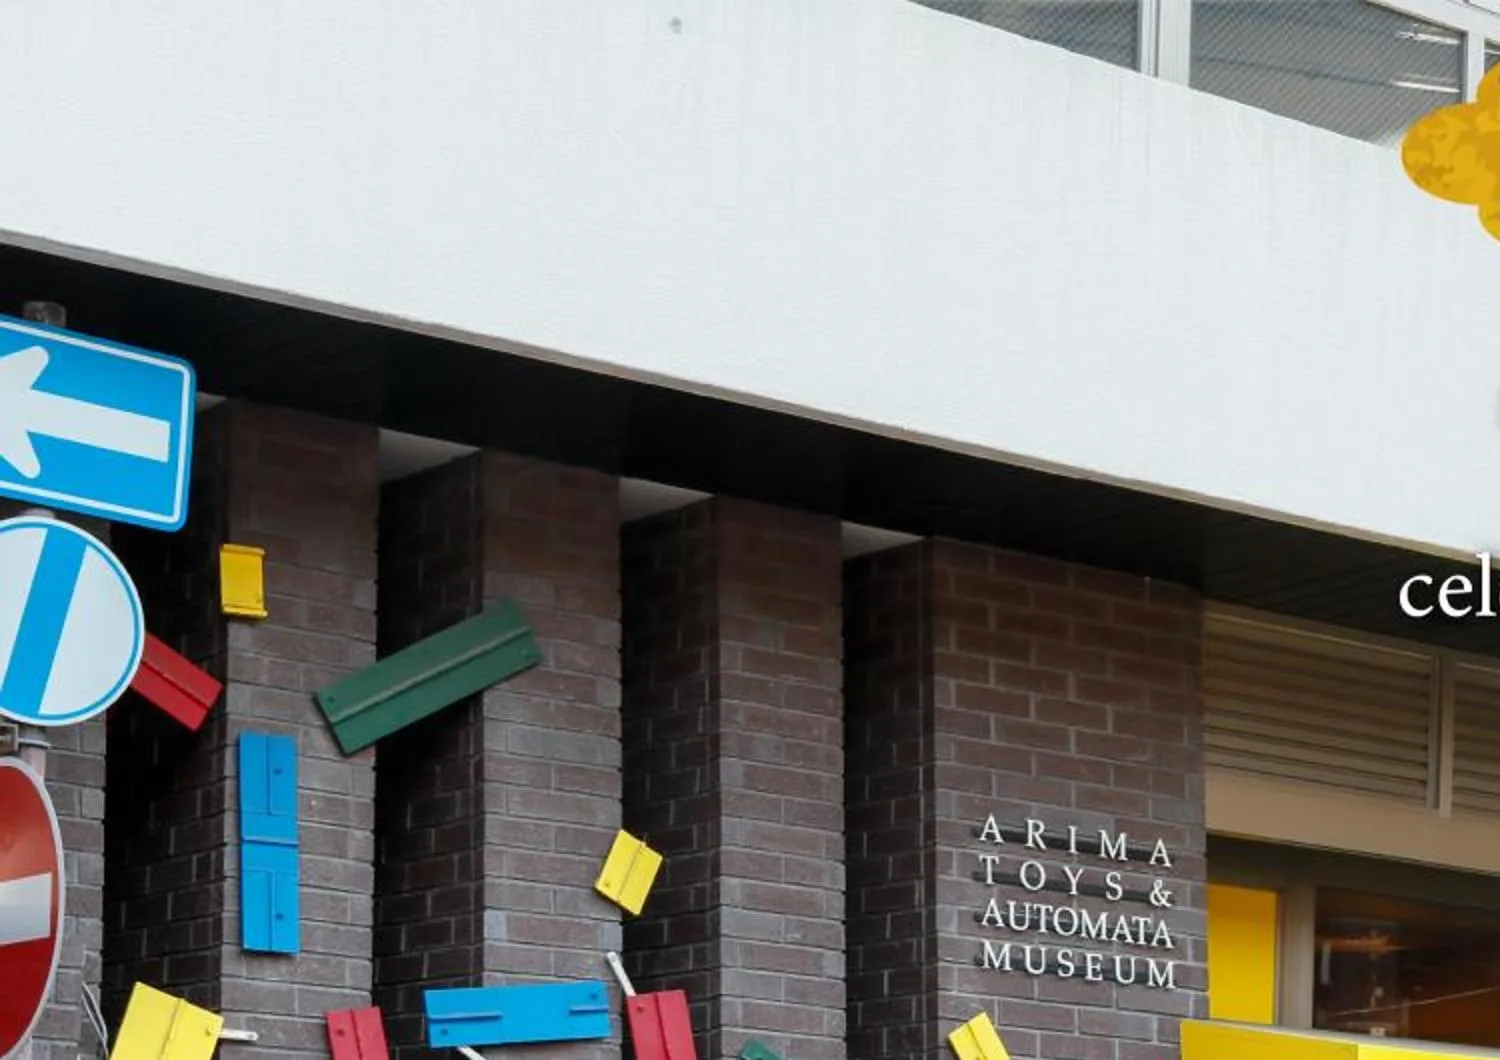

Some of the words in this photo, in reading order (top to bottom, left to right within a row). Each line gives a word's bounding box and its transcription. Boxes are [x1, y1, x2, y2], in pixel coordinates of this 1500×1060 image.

[978, 812, 1173, 868] ARIMA
[979, 854, 1124, 901] TOYS
[1149, 878, 1173, 908] &
[981, 896, 1175, 949] AUTOMATA
[982, 939, 1177, 989] MUSEUM
